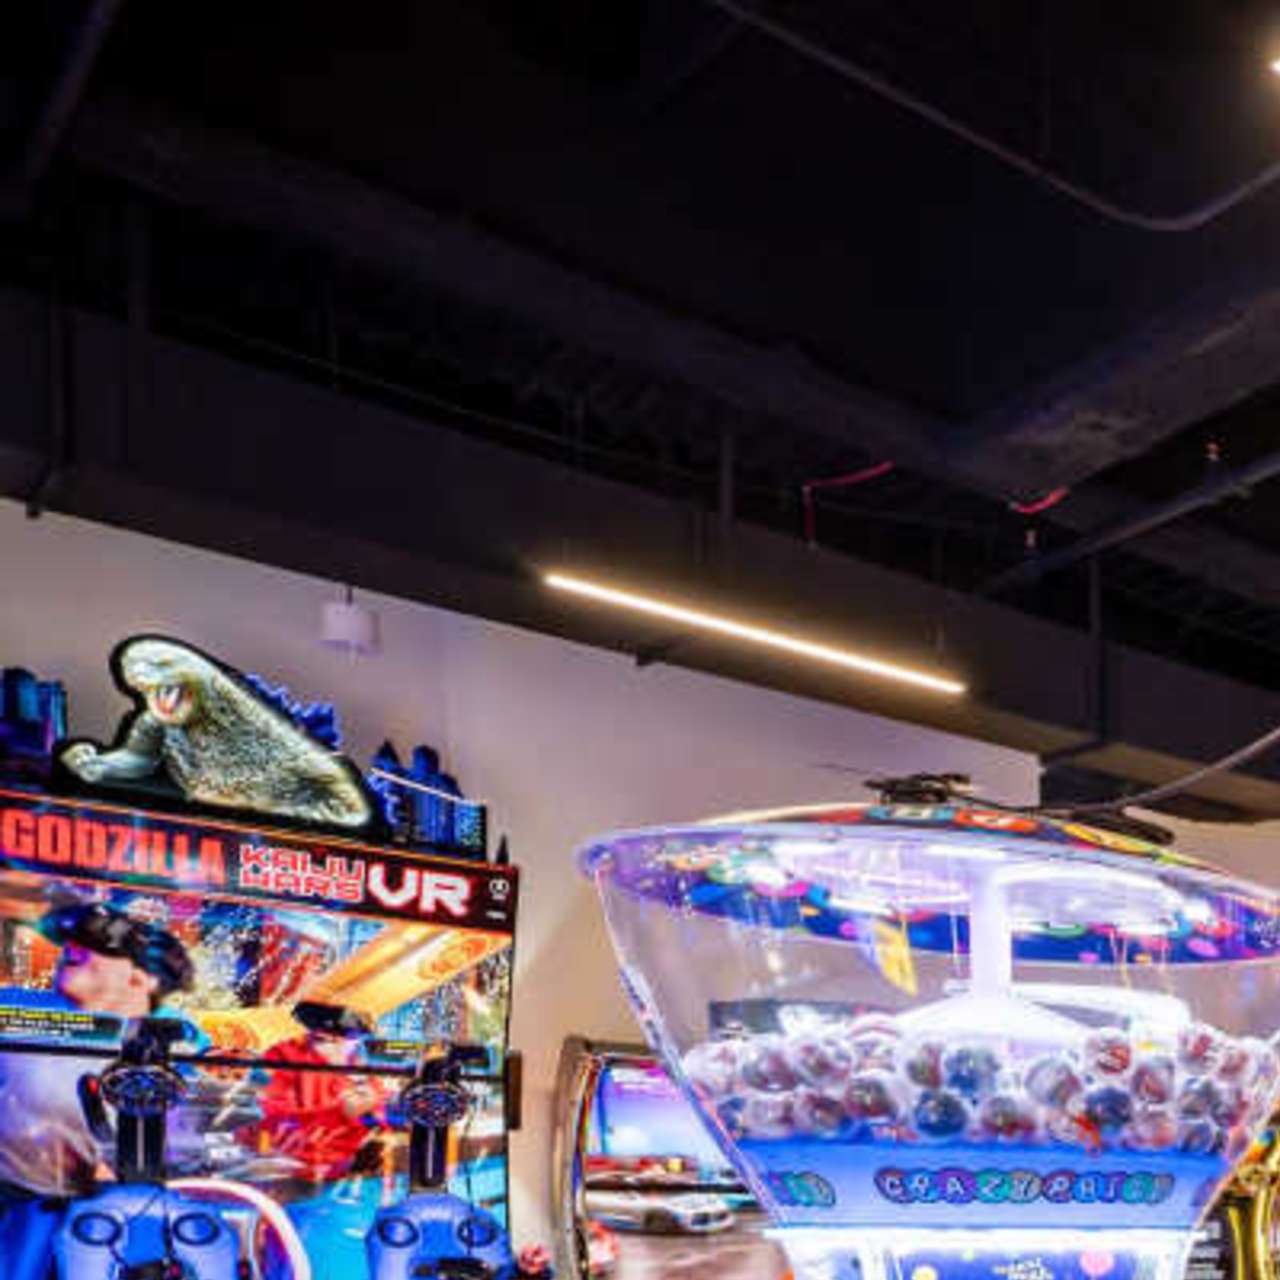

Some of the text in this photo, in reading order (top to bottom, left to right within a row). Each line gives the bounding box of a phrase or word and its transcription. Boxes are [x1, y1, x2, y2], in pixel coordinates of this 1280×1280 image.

[2, 807, 227, 886] GODZILLA
[240, 843, 472, 917] KAIJU VR
[882, 1170, 1038, 1202] CRAZY
